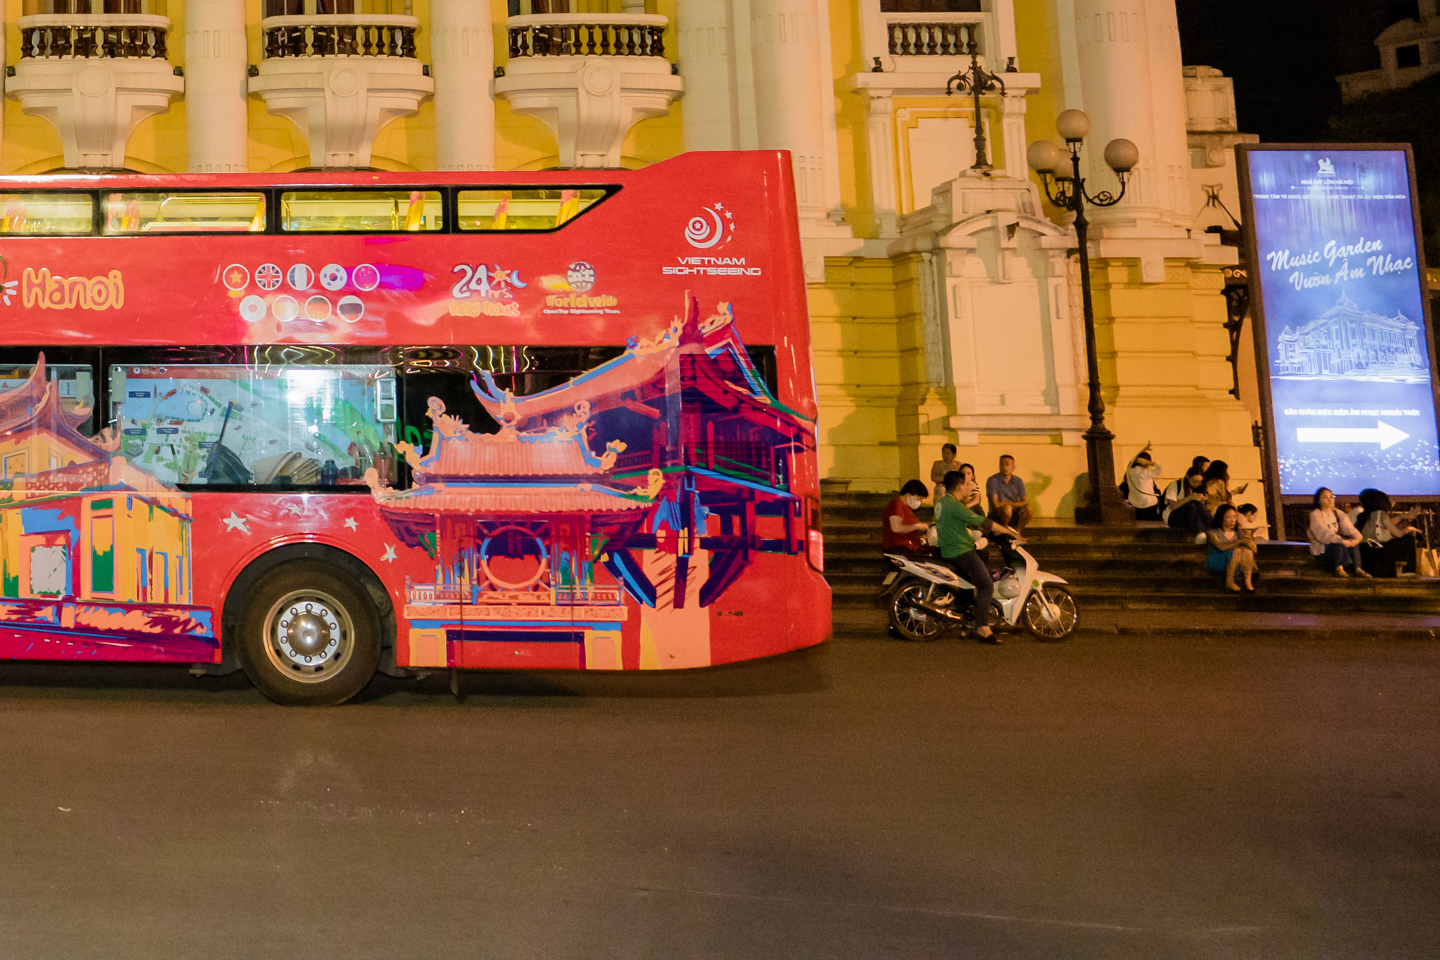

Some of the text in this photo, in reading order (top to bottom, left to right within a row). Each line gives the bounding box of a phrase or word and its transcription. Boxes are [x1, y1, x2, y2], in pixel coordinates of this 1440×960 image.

[677, 256, 745, 265] VIETNAM
[1266, 236, 1383, 271] Music Garden
[1334, 258, 1366, 285] Âm
[1366, 253, 1413, 276] Nhạc
[452, 264, 490, 298] 24
[662, 266, 762, 276] SIGHTSEEING
[22, 267, 124, 310] Hanoi
[545, 293, 618, 308] Worldwide
